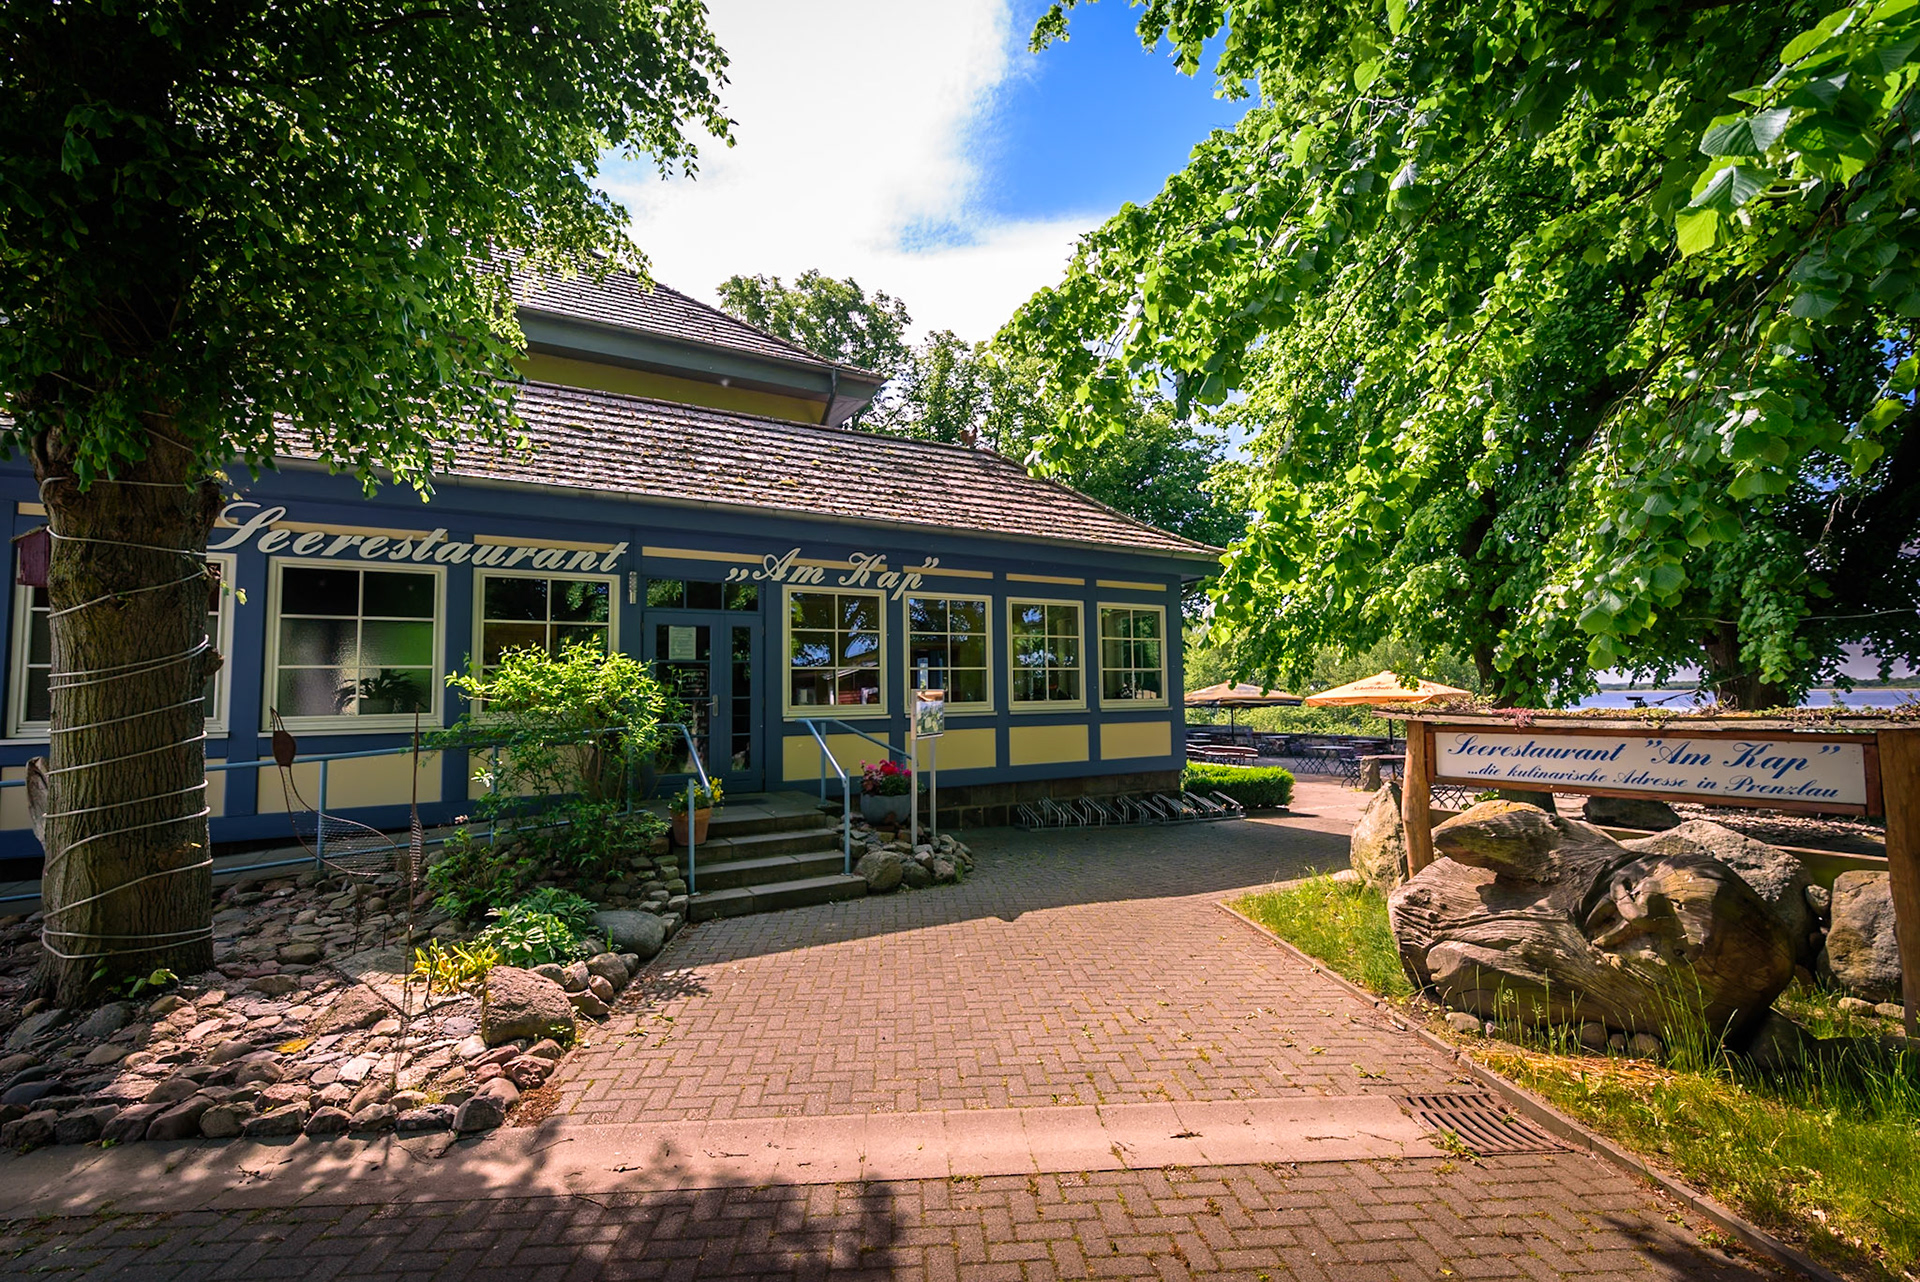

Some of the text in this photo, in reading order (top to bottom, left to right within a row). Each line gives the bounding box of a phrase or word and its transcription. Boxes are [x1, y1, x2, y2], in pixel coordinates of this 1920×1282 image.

[205, 501, 630, 572] Seerestaurant
[1448, 733, 1628, 763] Seerestaurant
[1506, 763, 1609, 784] kulinarische
[1612, 768, 1688, 788] Adresse
[1696, 776, 1719, 790] in
[1724, 774, 1840, 799] Prenzlau
